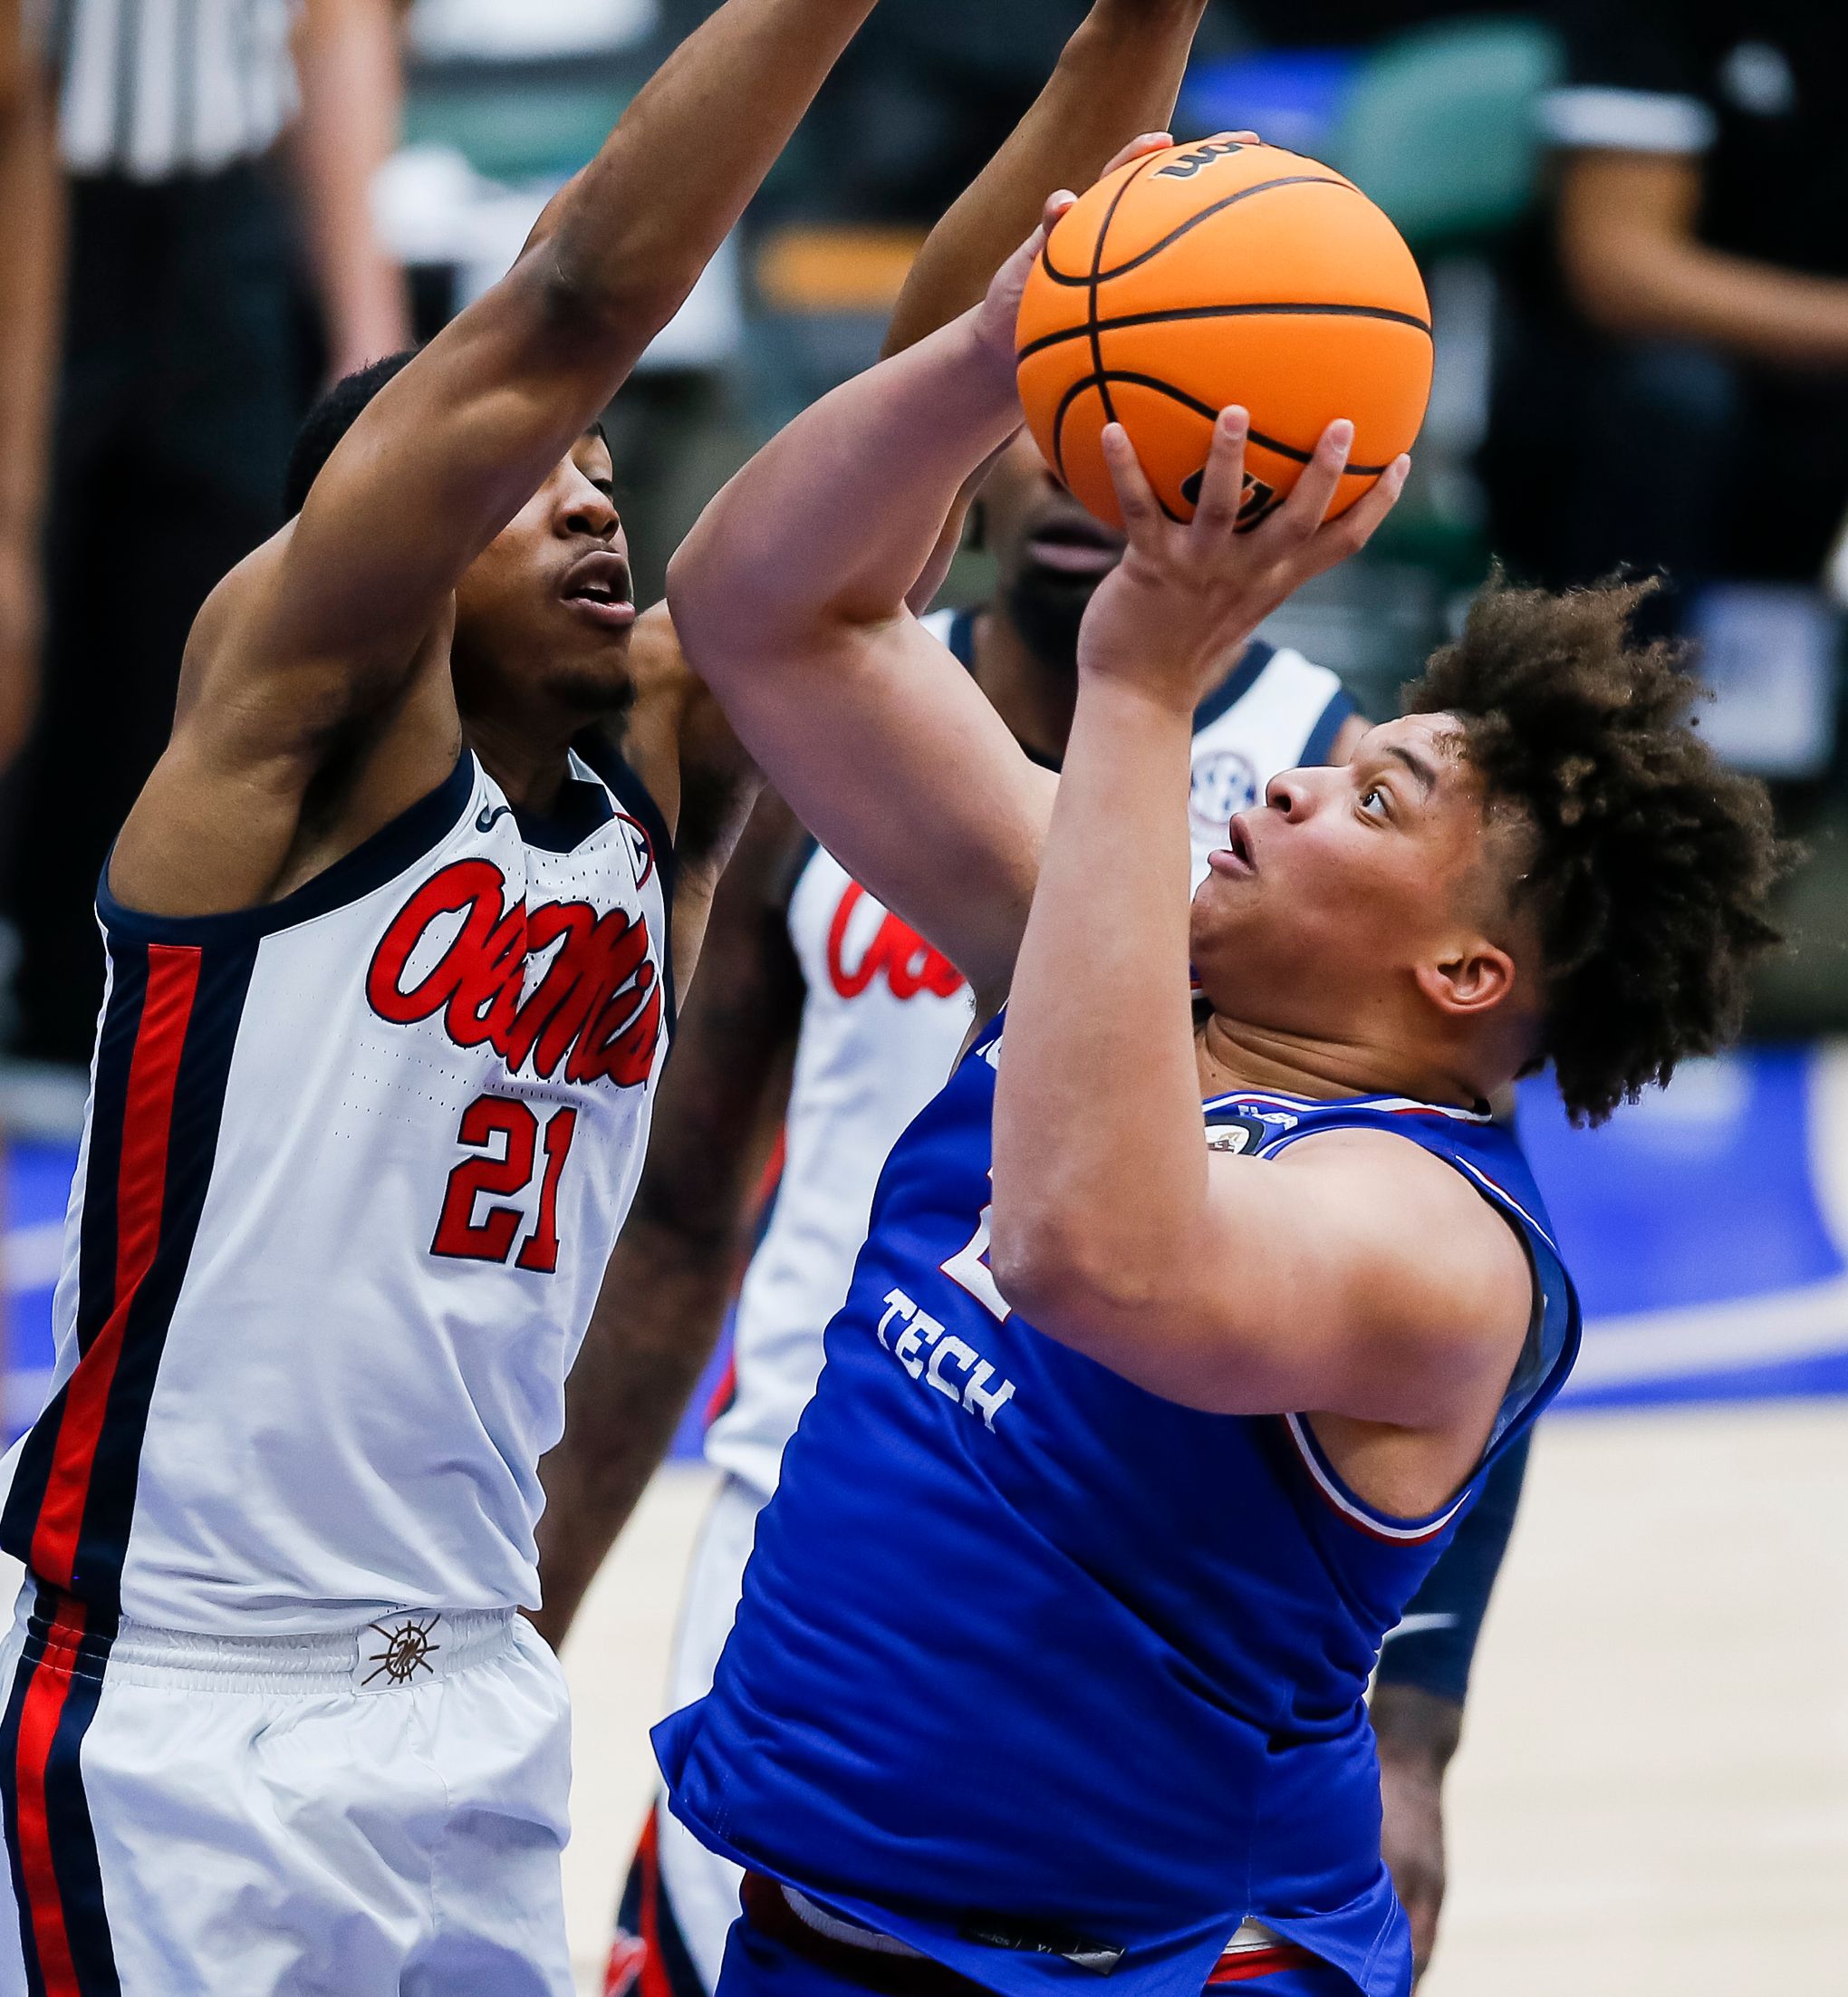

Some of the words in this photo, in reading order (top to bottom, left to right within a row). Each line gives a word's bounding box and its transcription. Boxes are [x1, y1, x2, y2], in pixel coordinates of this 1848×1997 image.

[365, 857, 527, 1058] Ole
[429, 1093, 577, 1273] 21
[877, 1287, 1015, 1434] TECH
